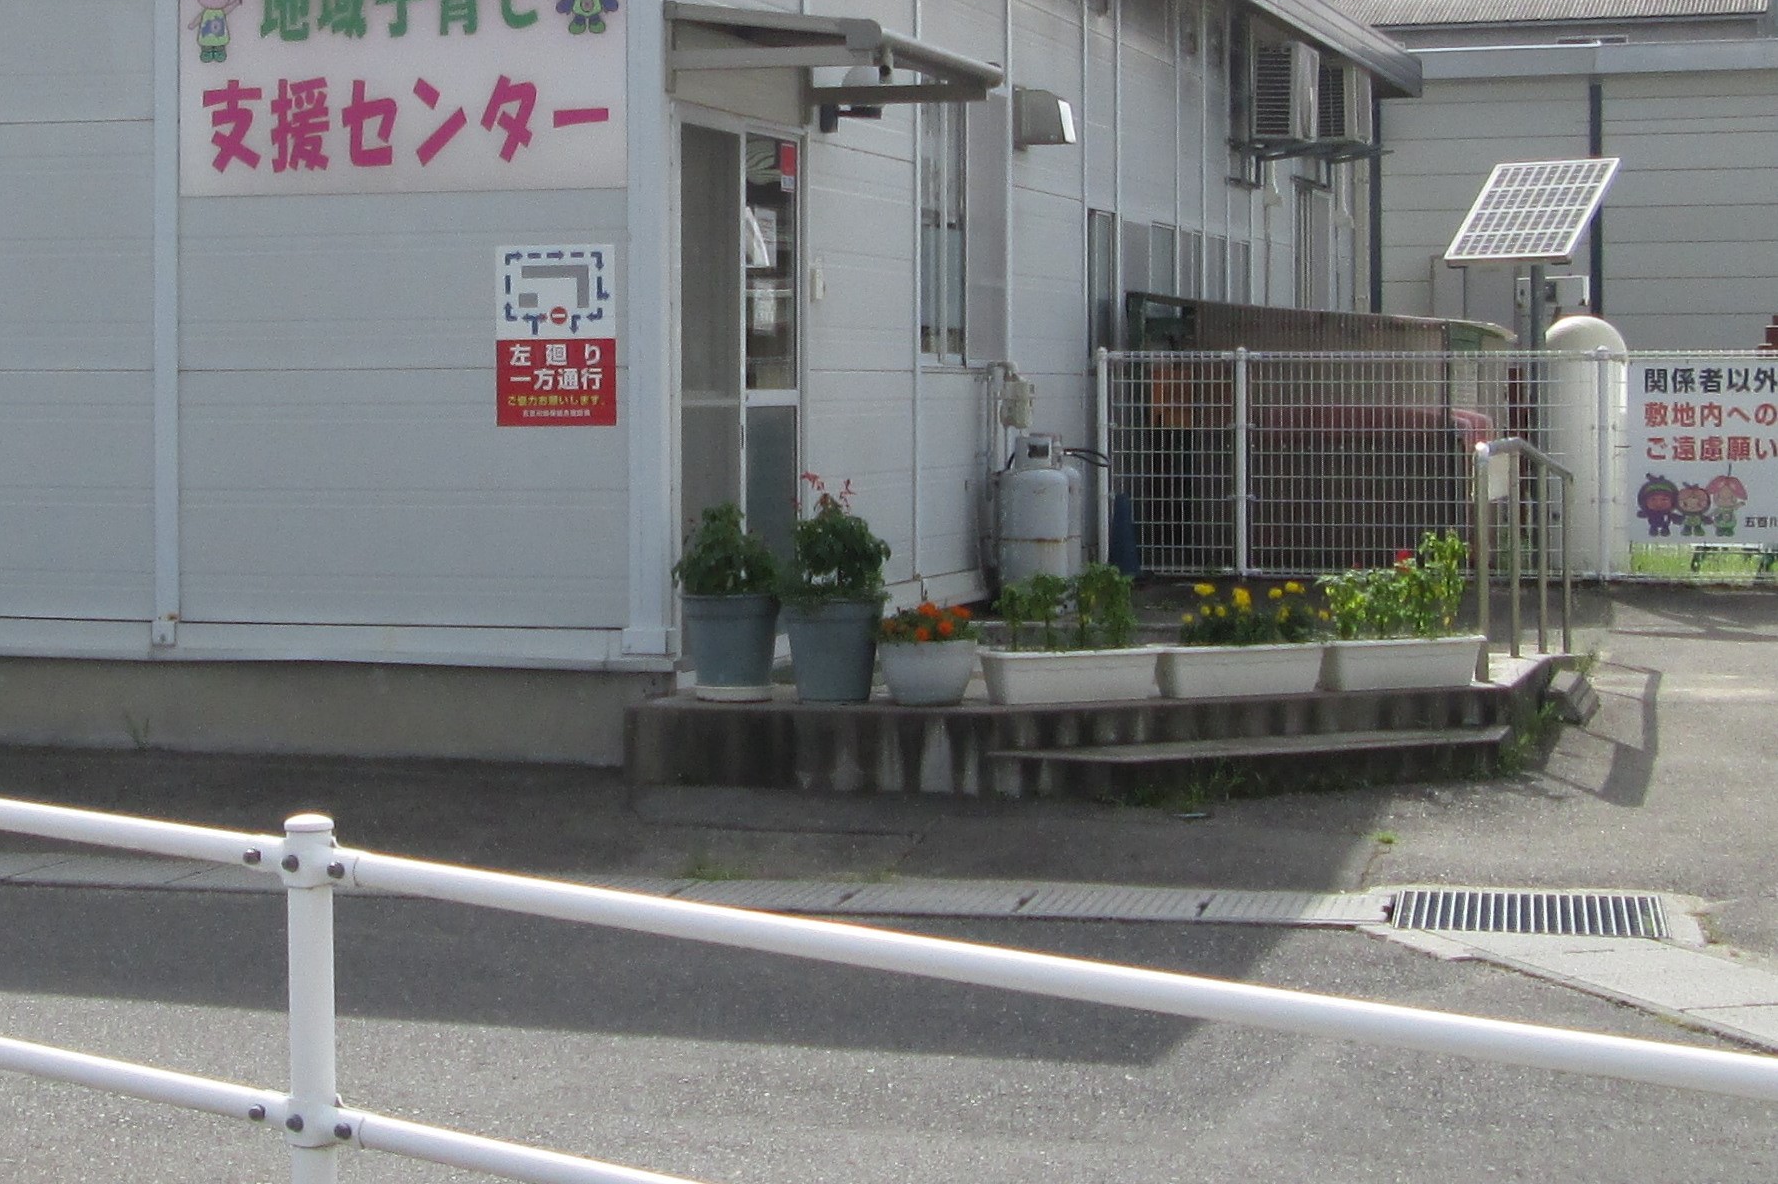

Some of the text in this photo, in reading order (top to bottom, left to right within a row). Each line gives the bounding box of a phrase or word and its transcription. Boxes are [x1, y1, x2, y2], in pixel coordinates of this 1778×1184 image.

[203, 75, 609, 173] 支援センター
[510, 368, 602, 390] 一方通行
[1644, 368, 1778, 393] 関係者以外
[1644, 402, 1777, 427] 敷地内への
[1646, 436, 1778, 461] ご遠慮願い
